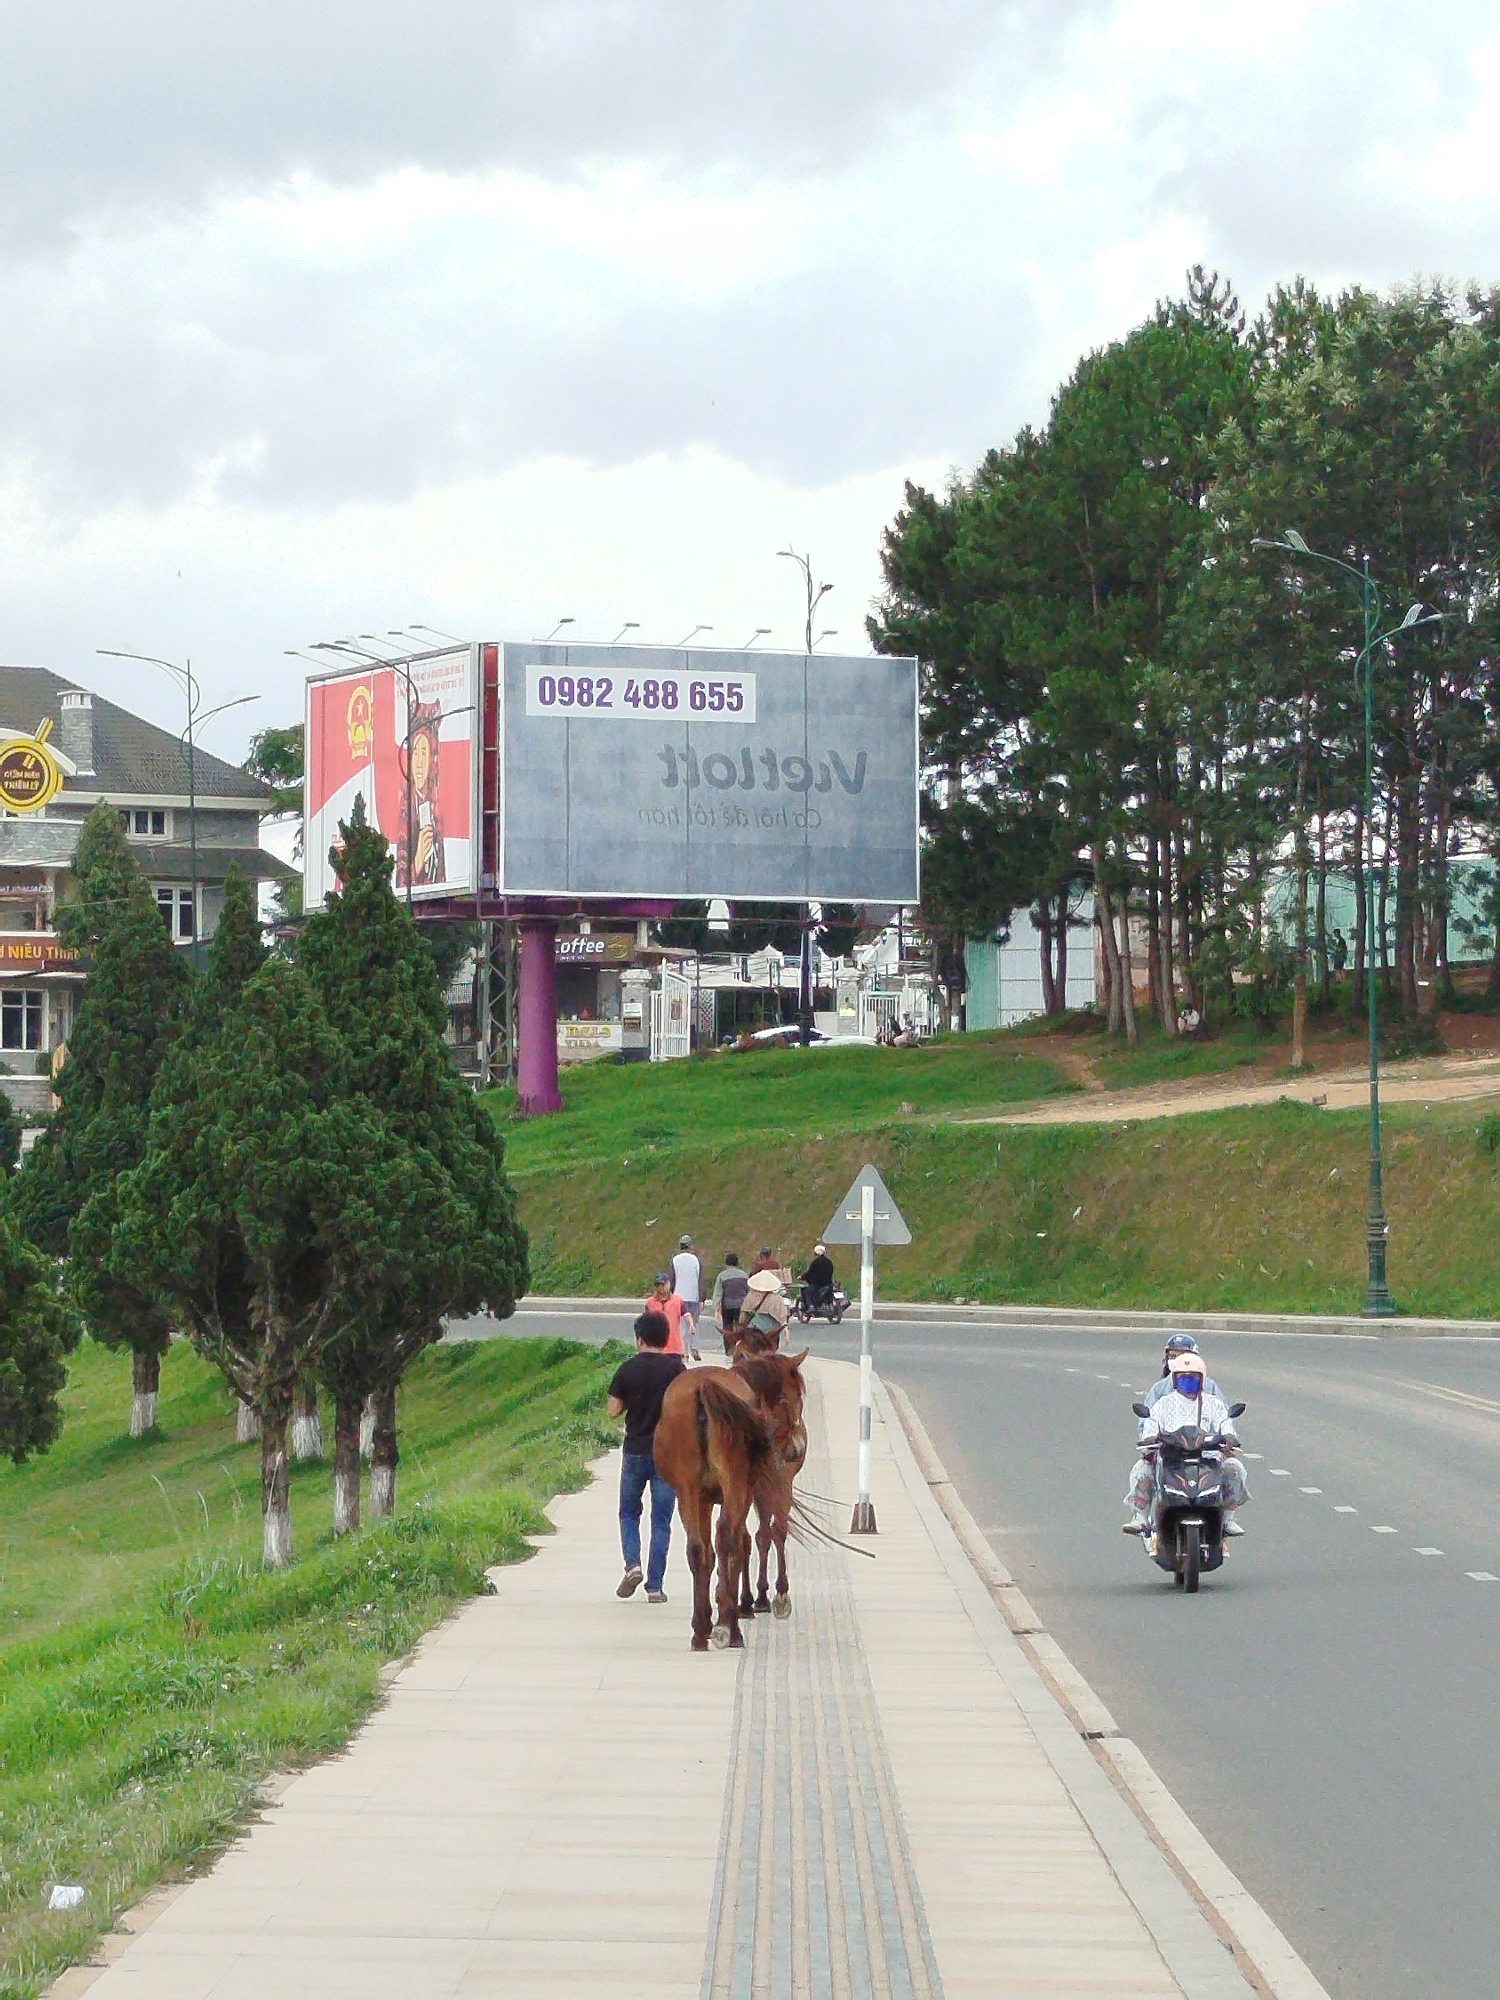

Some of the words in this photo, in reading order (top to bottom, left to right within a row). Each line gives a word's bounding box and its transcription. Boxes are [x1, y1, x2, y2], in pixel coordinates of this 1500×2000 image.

[538, 676, 613, 707] 0982
[624, 679, 679, 709] 488
[689, 681, 744, 711] 655
